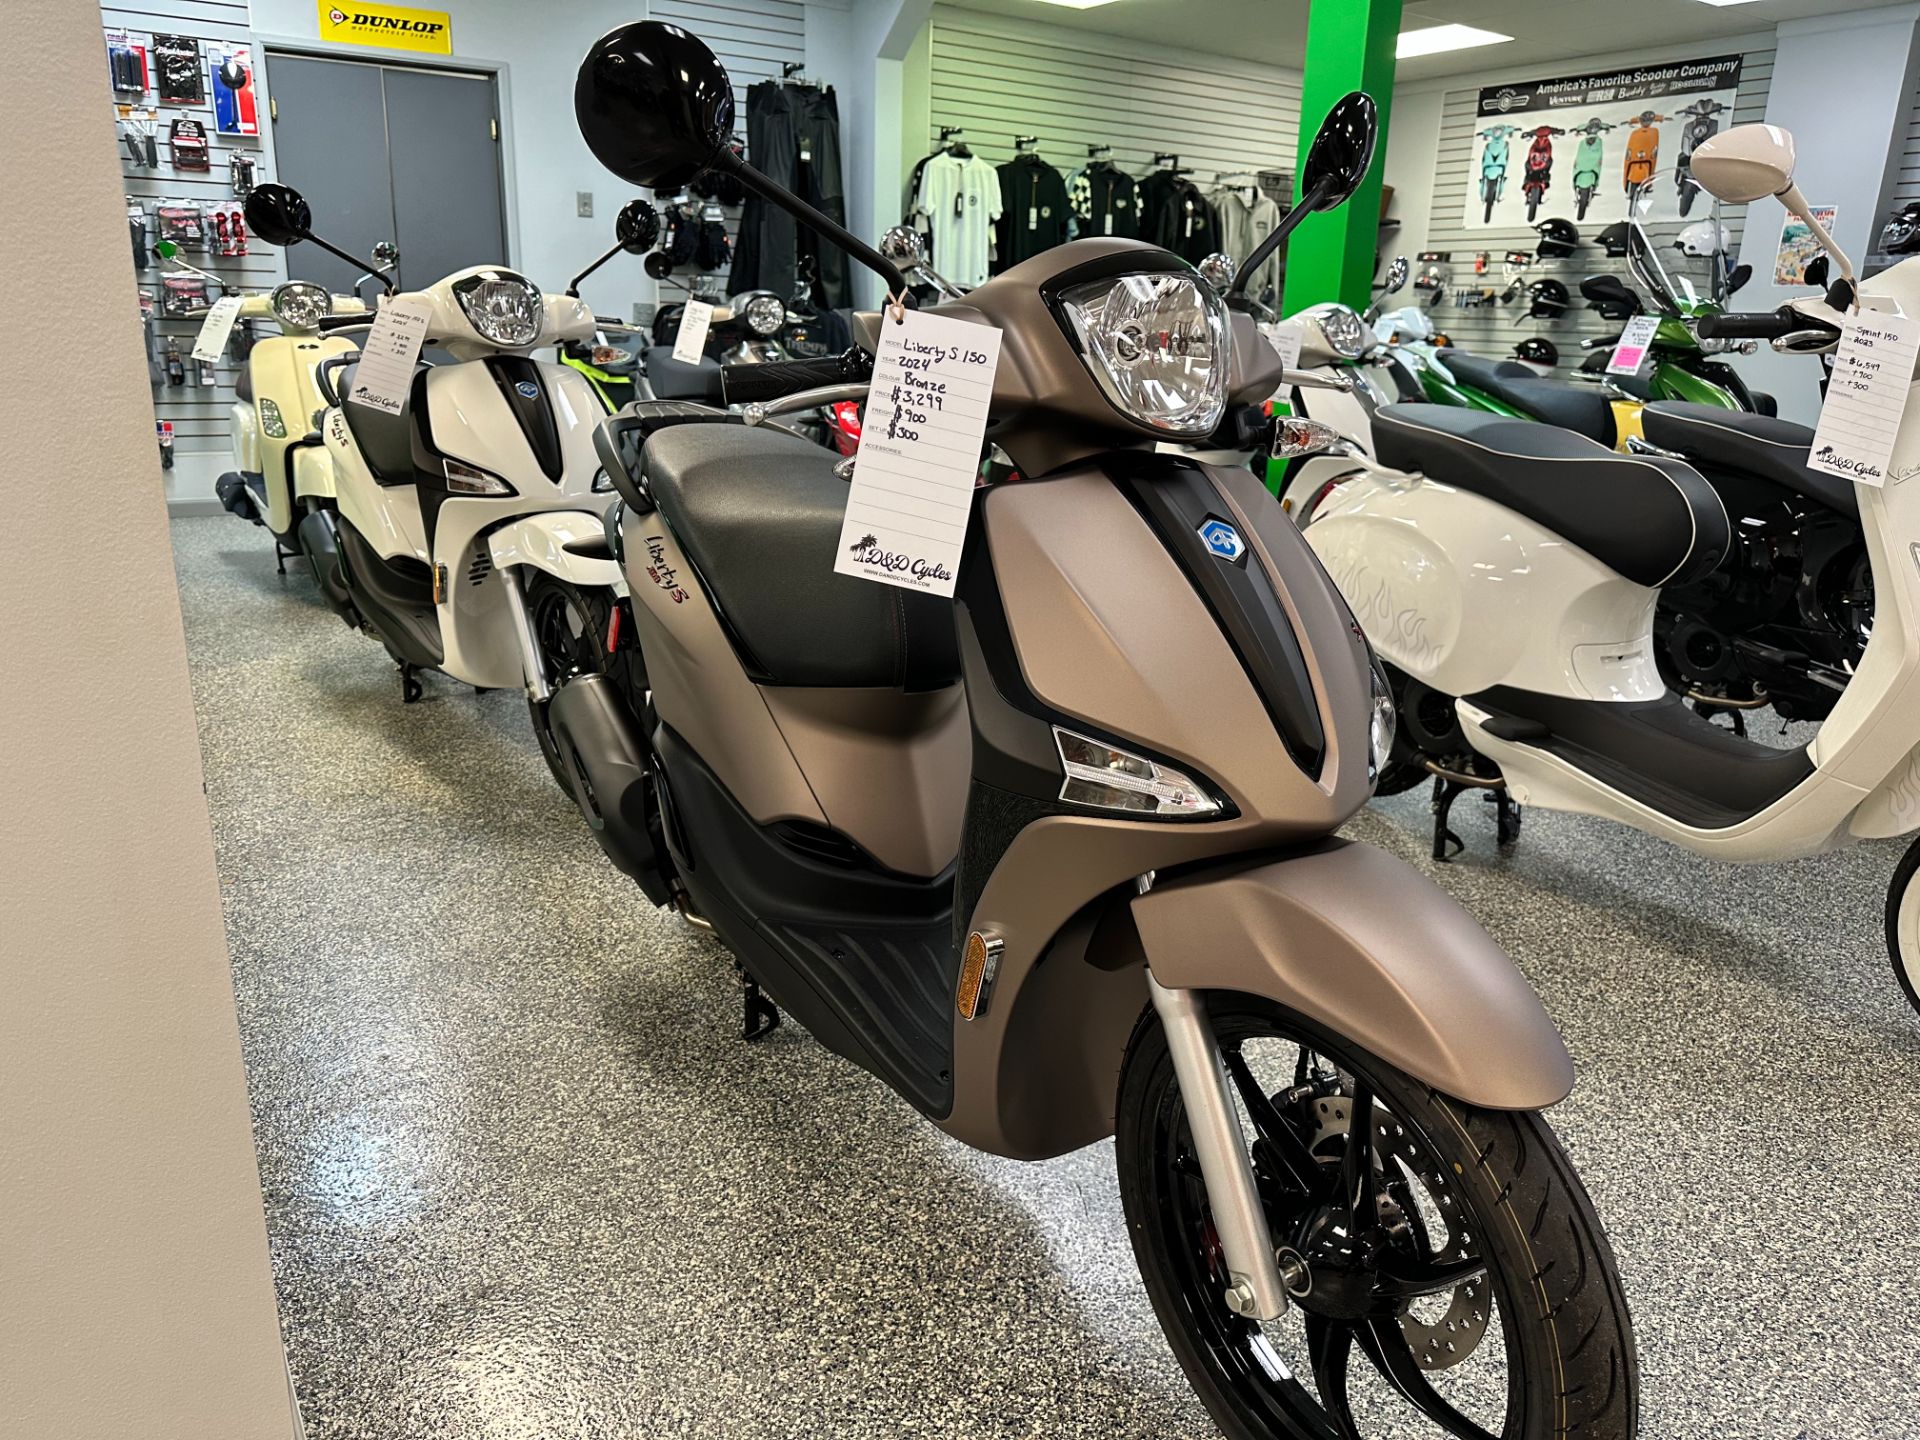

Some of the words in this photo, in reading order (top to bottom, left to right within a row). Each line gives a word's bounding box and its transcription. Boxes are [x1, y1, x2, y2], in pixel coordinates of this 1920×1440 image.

[351, 13, 444, 34] DUNLOP
[351, 25, 406, 37] MOTORCYCLE
[1536, 77, 1588, 96] America's
[1588, 72, 1632, 89] Favorite
[1633, 67, 1680, 83] Scooter
[1680, 59, 1739, 78] Company
[1618, 86, 1646, 100] Buddy
[1853, 336, 1874, 348] 2023
[1856, 326, 1882, 338] Sprint
[1883, 332, 1899, 341] 150
[903, 338, 946, 364] Liberty
[948, 346, 959, 360] S
[962, 350, 987, 365] 150
[898, 356, 931, 372] 2024
[904, 371, 947, 394] Bronze
[891, 385, 943, 412] $3,299
[894, 404, 927, 424] $900
[887, 419, 919, 441] $300
[1825, 454, 1854, 470] D&D
[1854, 462, 1881, 478] Cycles
[644, 536, 679, 590] Liberty
[670, 587, 690, 604] S
[865, 548, 910, 572] D&D
[910, 558, 952, 581] Cycles
